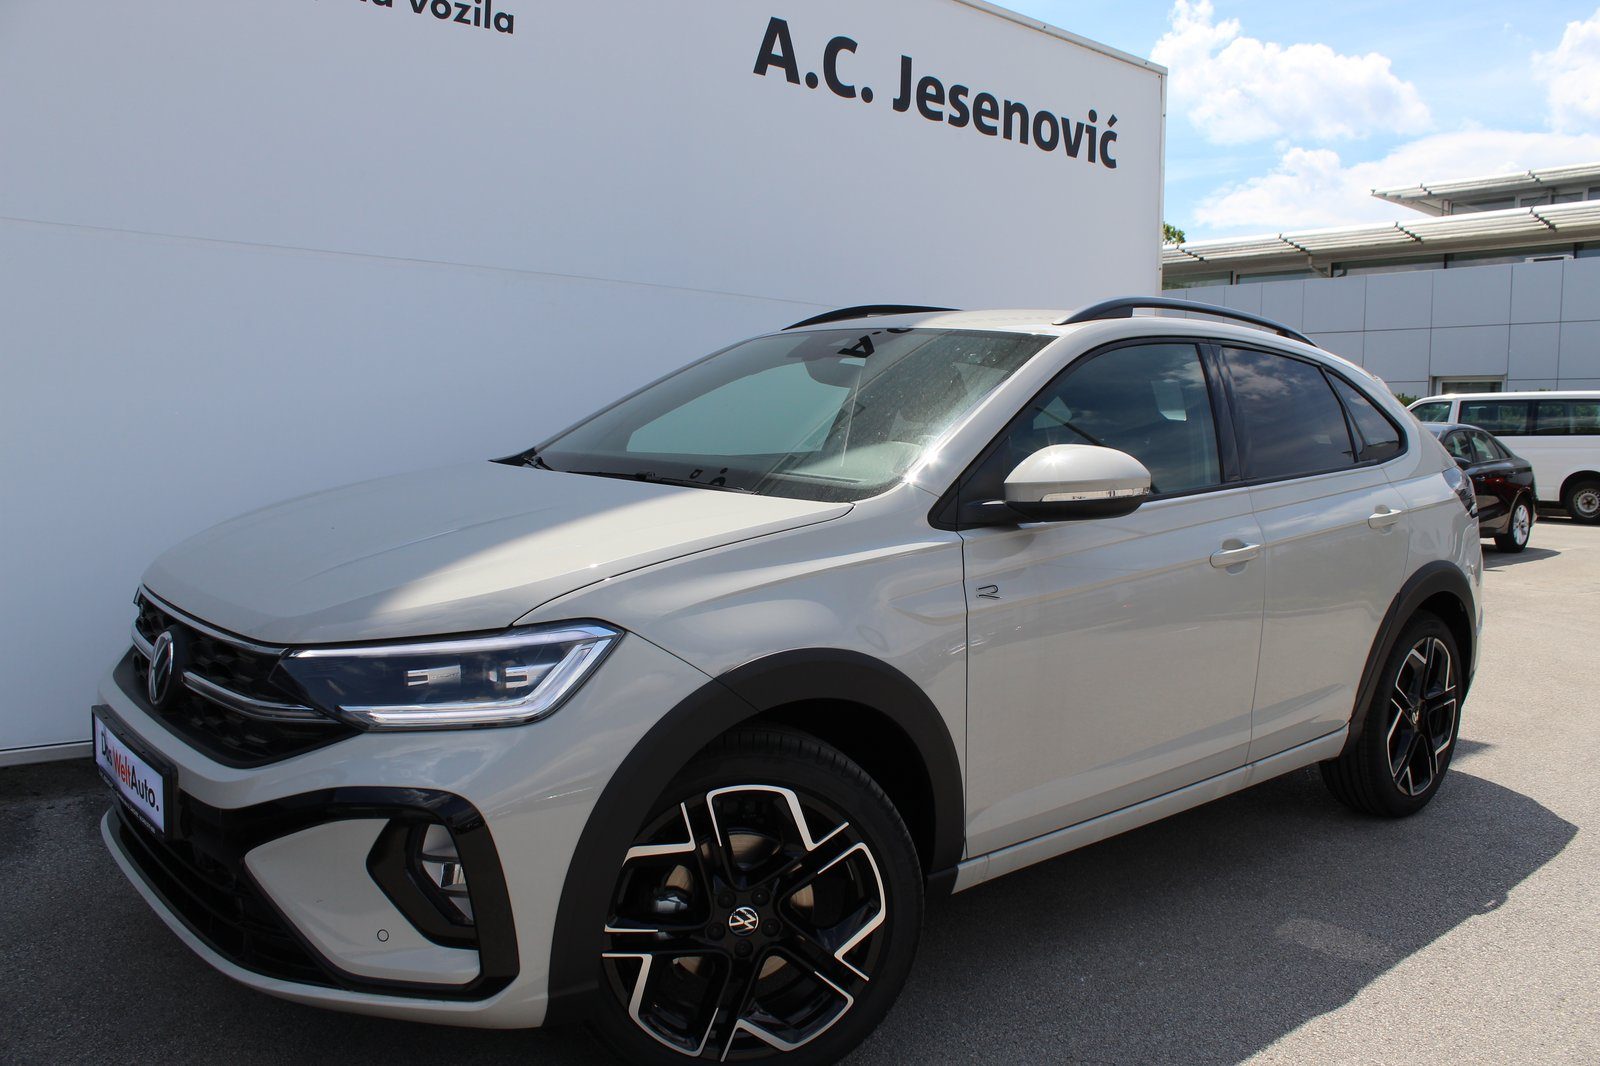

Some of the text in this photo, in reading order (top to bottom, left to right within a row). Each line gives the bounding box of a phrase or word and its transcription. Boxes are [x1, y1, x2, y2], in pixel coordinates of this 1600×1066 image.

[409, 0, 515, 35] vozila
[753, 16, 1118, 169] A.C. Jesenović
